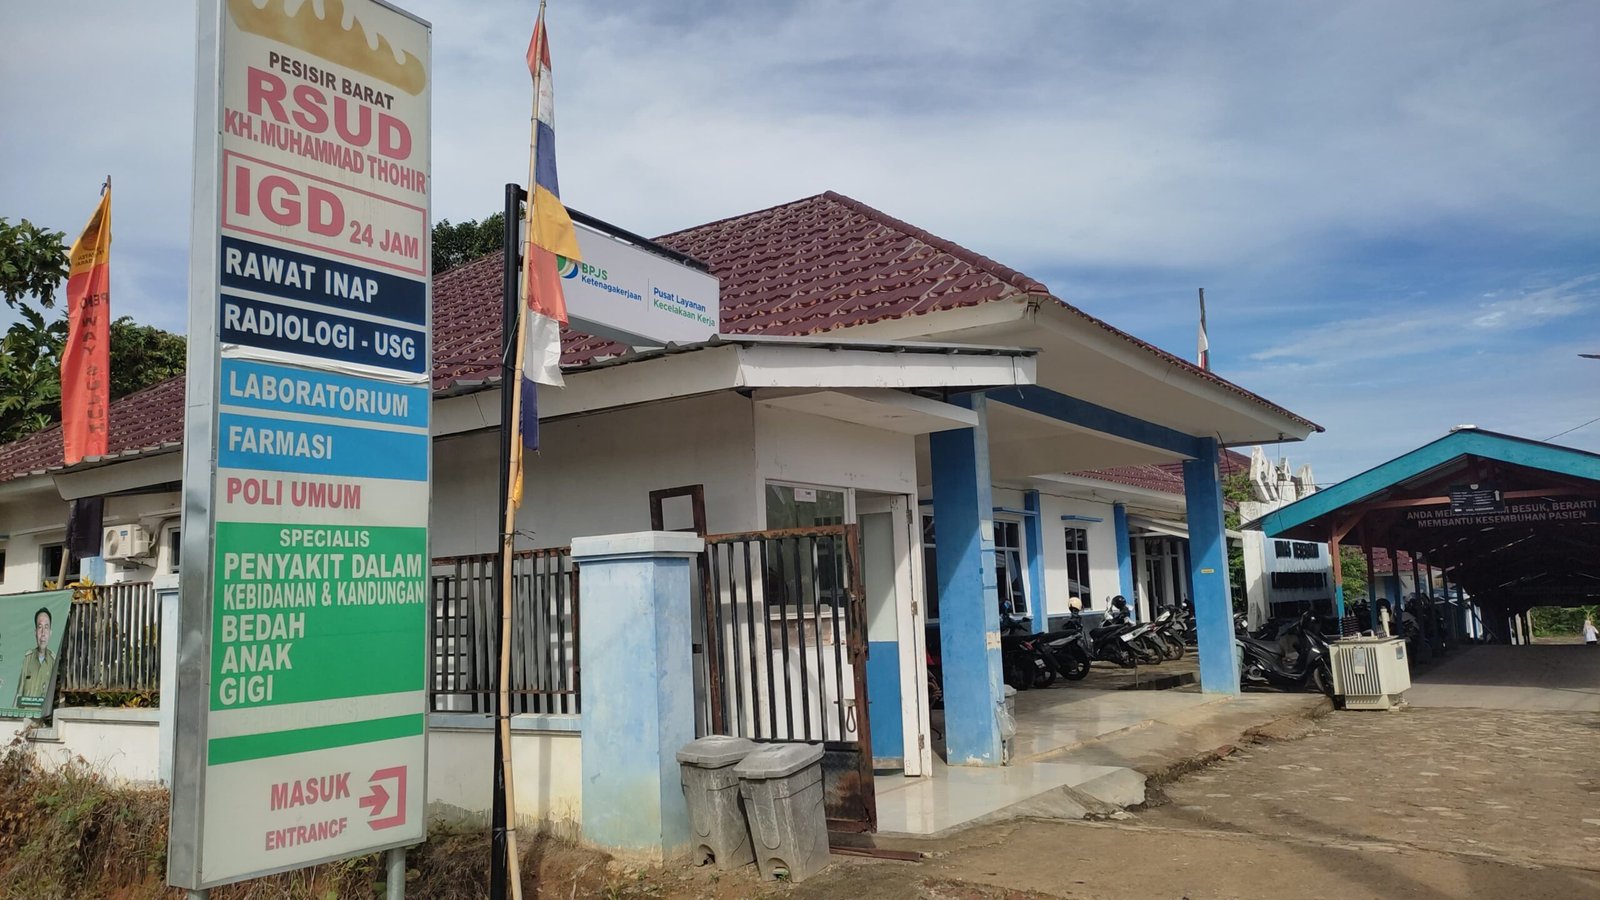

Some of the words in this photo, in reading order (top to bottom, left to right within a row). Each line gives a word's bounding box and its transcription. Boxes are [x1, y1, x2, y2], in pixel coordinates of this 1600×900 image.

[269, 51, 336, 91] PESISIR
[342, 78, 395, 110] BARAT
[248, 66, 412, 161] RSUD
[367, 155, 426, 195] THOHIR
[235, 165, 345, 237] IGD
[350, 220, 374, 248] 24
[379, 229, 419, 260] JAM
[225, 247, 316, 291] RAWAT
[325, 269, 379, 303] INAP
[581, 263, 608, 281] BPJS
[581, 274, 642, 302] Ketenagakerjaan
[653, 287, 675, 302] Pusat
[676, 295, 706, 313] Layanan
[653, 299, 696, 320] Kecelakaan
[697, 314, 716, 327] Kerja
[224, 303, 355, 350] RADIOLOGI
[375, 331, 415, 360] USG
[229, 370, 408, 418] LABORATORIUM
[229, 425, 333, 460] FARMASI
[226, 477, 283, 506] POLI
[291, 481, 361, 510] UMUM
[1407, 511, 1433, 521] ANDA
[1512, 502, 1550, 514] BESUK,
[1552, 500, 1597, 511] BERARTI
[1417, 517, 1473, 528] MEMBANTU
[1475, 513, 1547, 525] KESEMBUHAN
[1549, 510, 1586, 521] PASIEN
[279, 528, 370, 548] SPECIALIS
[224, 552, 344, 580] PENYAKIT
[352, 553, 422, 578] DALAM
[223, 582, 316, 610] KEBIDANAN
[321, 583, 332, 606] &
[337, 580, 424, 606] KANDUNGAN
[222, 612, 305, 643] BEDAH
[221, 643, 293, 674] ANAK
[219, 674, 273, 706] GIGI
[270, 772, 352, 812] MASUK
